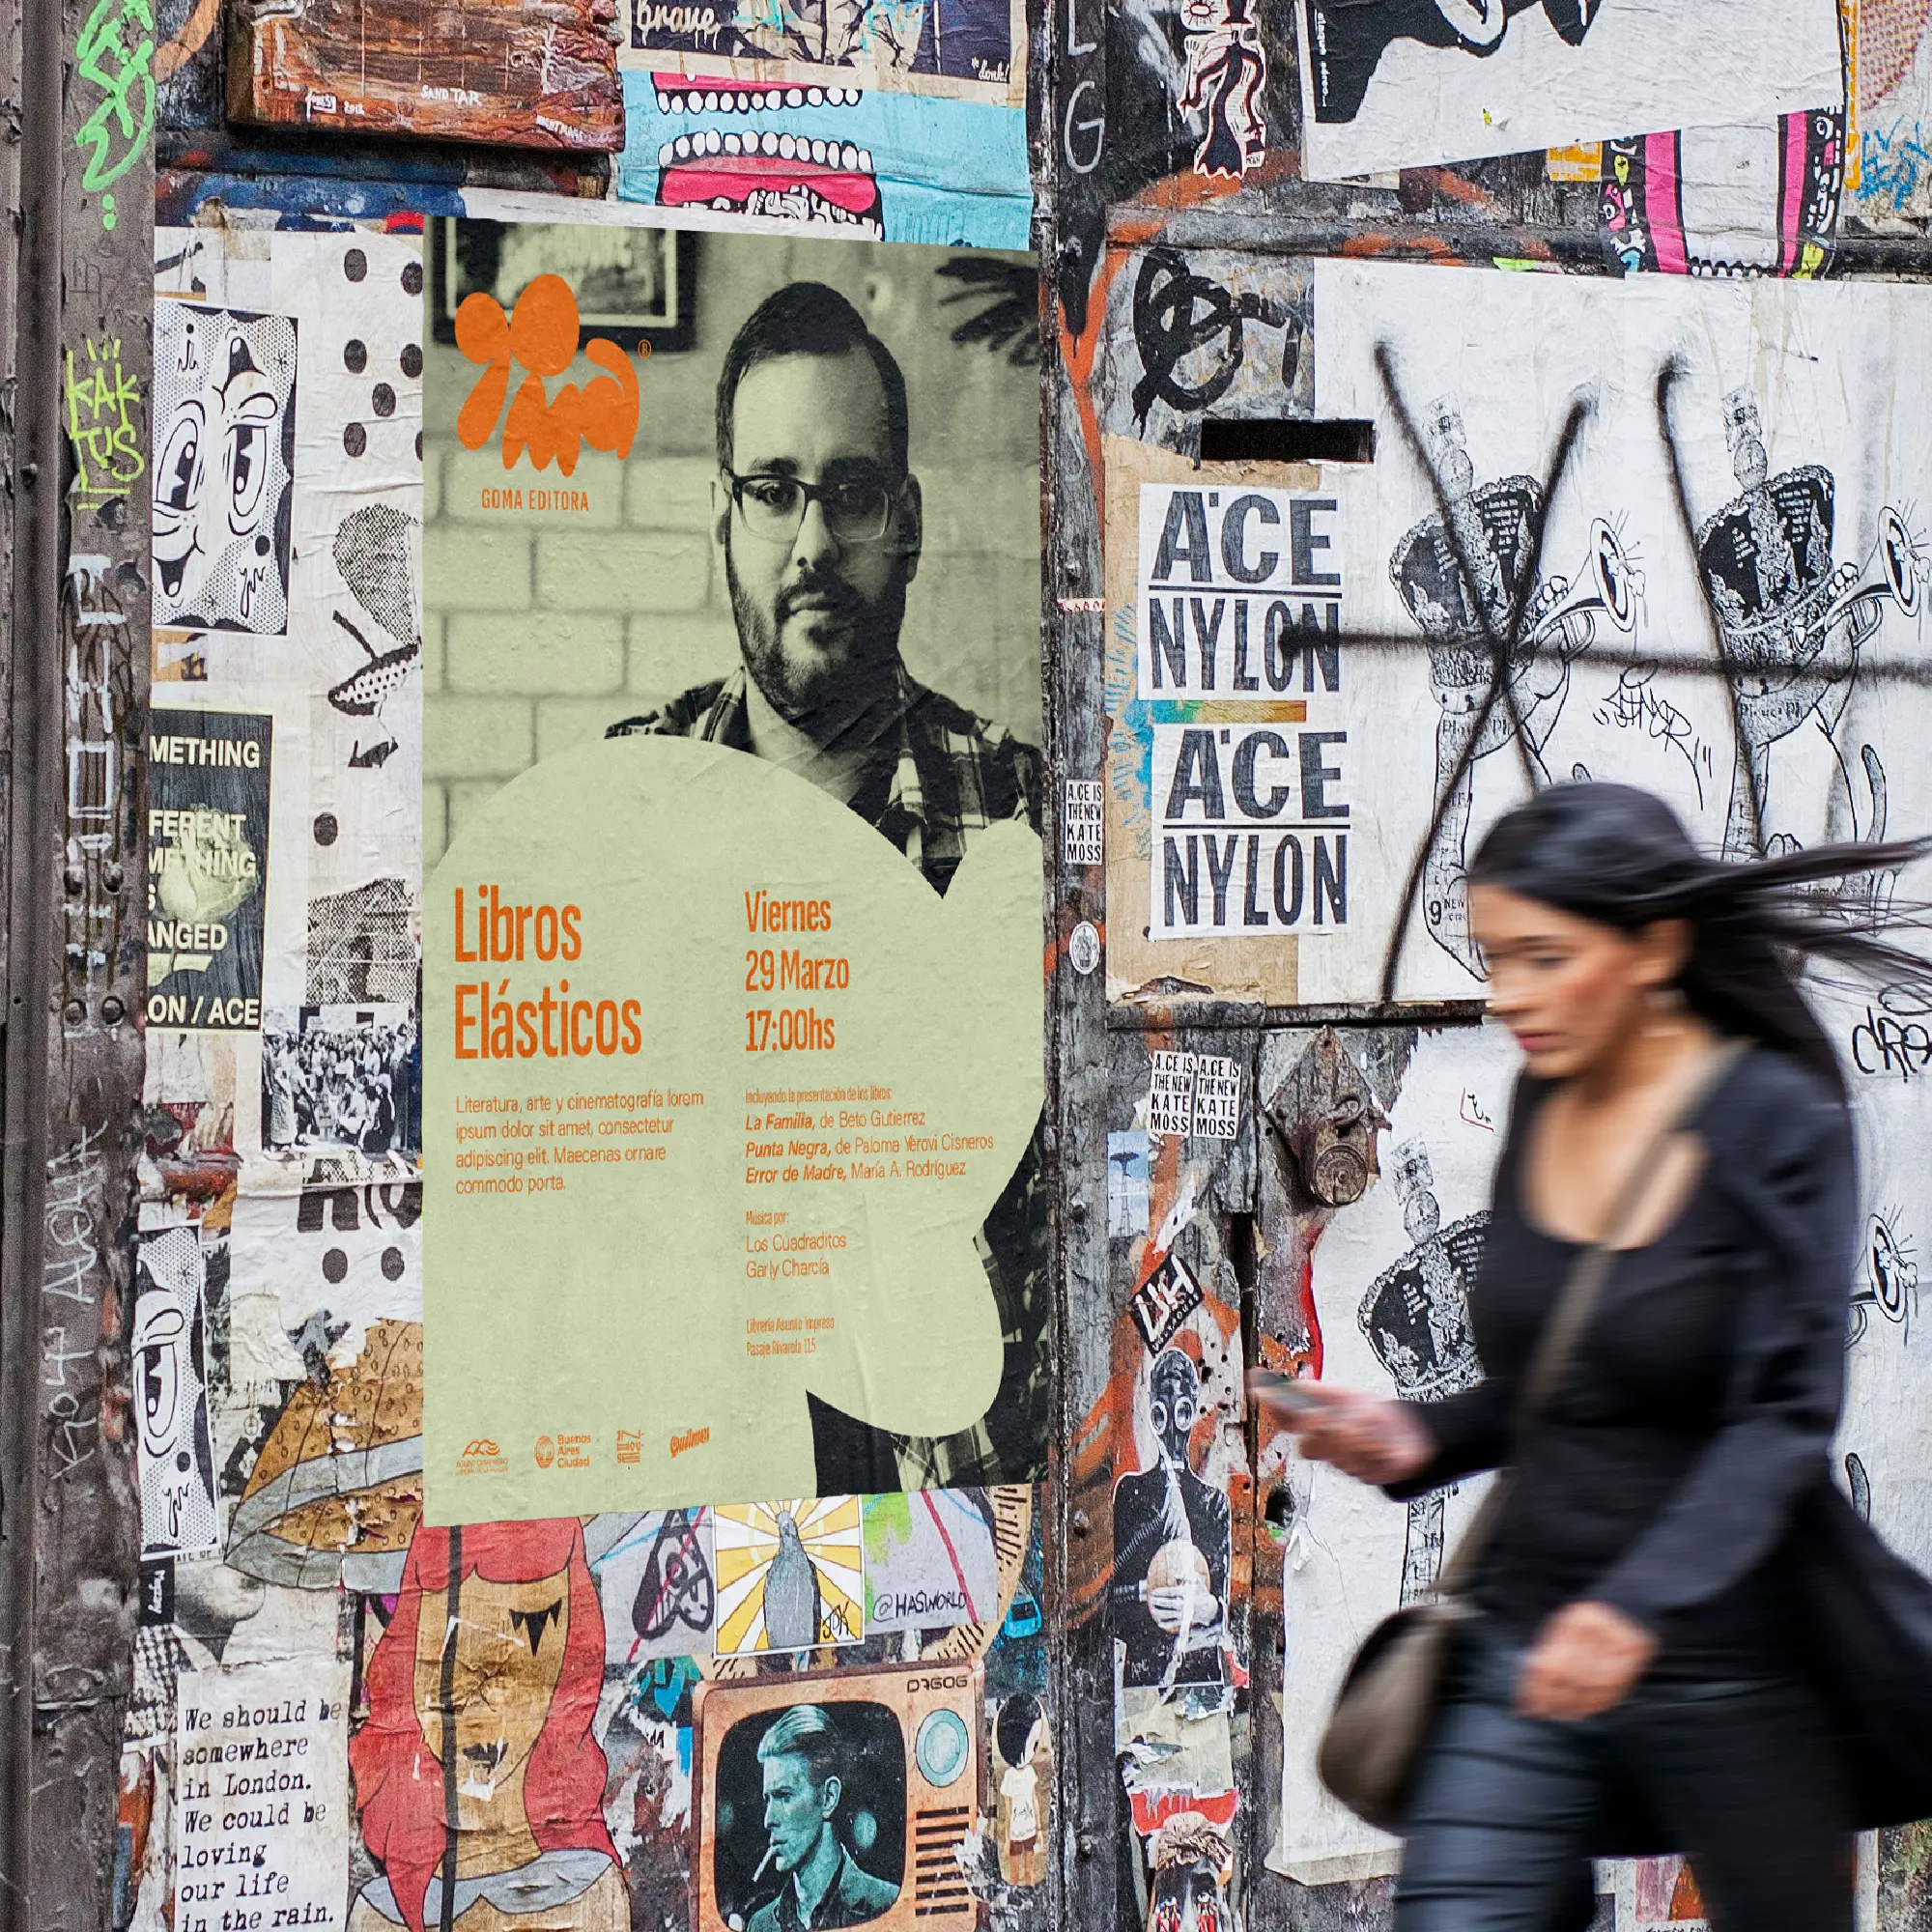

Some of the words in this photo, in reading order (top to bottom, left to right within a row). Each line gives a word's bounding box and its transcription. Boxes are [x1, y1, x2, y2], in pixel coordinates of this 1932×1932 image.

[481, 488, 523, 510] GOMA
[528, 489, 589, 511] EDITORA
[1150, 597, 1340, 693] NYLON
[1067, 824, 1101, 841] KATE
[1067, 844, 1101, 862] MOSS
[1163, 834, 1347, 926] NYLON
[455, 884, 582, 962] Libros
[745, 890, 831, 932] Viernes
[745, 950, 775, 991] 29
[780, 949, 850, 991] Marzo
[207, 996, 260, 1026] ACE
[455, 979, 641, 1059] Elásticos
[745, 1008, 835, 1051] 17:00hs
[745, 1088, 786, 1105] Incluyendo
[787, 1088, 795, 1102] la
[847, 1086, 857, 1101] de
[857, 1085, 868, 1100] los
[1154, 1074, 1169, 1091] THE
[1172, 1076, 1192, 1093] NEW
[1199, 1078, 1216, 1094] THE
[1218, 1080, 1237, 1096] NEW
[455, 1095, 524, 1114] Literatura,
[526, 1095, 551, 1111] arte
[555, 1097, 563, 1116] y
[567, 1089, 663, 1112] cinematografía
[668, 1089, 704, 1106] lorem
[1151, 1094, 1189, 1112] KATE
[1198, 1097, 1236, 1117] KATE
[455, 1122, 497, 1144] ipsum
[501, 1120, 534, 1138] dolor
[538, 1119, 554, 1136] sit
[557, 1120, 594, 1138] amet,
[598, 1117, 674, 1135] consectetur
[745, 1113, 761, 1130] La
[765, 1112, 815, 1131] Familia,
[820, 1111, 835, 1128] de
[838, 1111, 867, 1128] Beto
[870, 1109, 925, 1126] Gutierrez
[1151, 1113, 1189, 1133] MOSS
[1197, 1119, 1236, 1137] MOSS
[455, 1149, 524, 1171] adipiscing
[527, 1146, 550, 1165] elit.
[554, 1146, 621, 1164] Maecenas
[624, 1146, 667, 1161] ornare
[745, 1141, 783, 1158] Punta
[787, 1140, 832, 1159] Negra,
[835, 1137, 851, 1155] de
[855, 1136, 899, 1154] Paloma
[904, 1133, 938, 1151] Yerovi
[941, 1133, 994, 1151] Cisneros
[745, 1166, 778, 1183] Error
[782, 1164, 799, 1182] de
[803, 1162, 846, 1182] Madre,
[851, 1160, 885, 1179] María
[890, 1160, 902, 1178] A.
[906, 1158, 967, 1180] Rodríguez
[455, 1175, 524, 1194] commodo
[527, 1175, 566, 1195] porta.
[746, 1209, 773, 1226] Música
[746, 1236, 768, 1253] Los
[773, 1231, 847, 1252] Cuadraditos
[781, 1257, 830, 1277] Charcía
[557, 1434, 591, 1445] Buenos
[557, 1445, 581, 1456] Aires
[556, 1455, 589, 1468] Ciudad
[185, 1709, 212, 1731] We
[222, 1700, 306, 1727] should
[319, 1698, 342, 1721] be
[183, 1737, 308, 1766] somewhere
[183, 1777, 210, 1800] in
[223, 1770, 311, 1797] London.
[185, 1810, 212, 1833] We
[223, 1803, 289, 1831] could
[304, 1802, 326, 1823] be
[181, 1842, 267, 1868] loving
[181, 1882, 225, 1902] our
[236, 1871, 289, 1897] life
[182, 1914, 208, 1932] in
[222, 1909, 262, 1931] the
[271, 1902, 334, 1927] rain.
